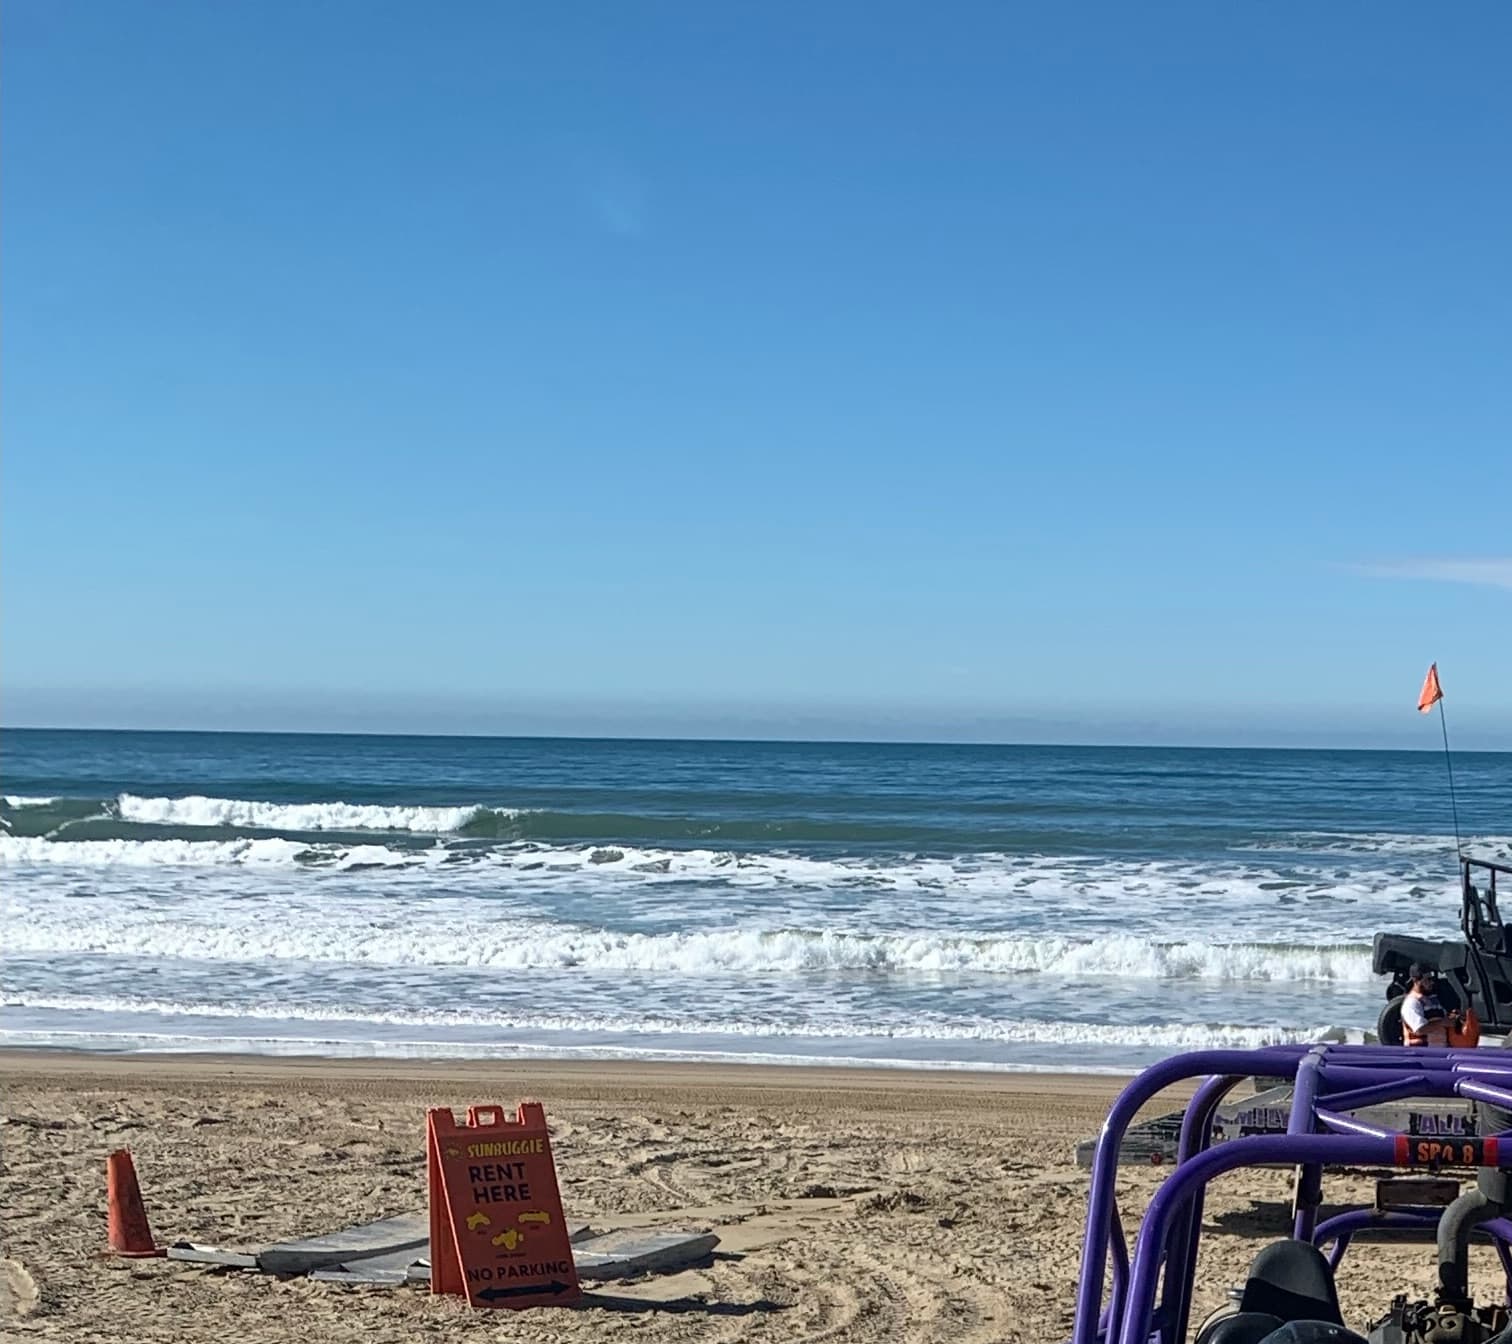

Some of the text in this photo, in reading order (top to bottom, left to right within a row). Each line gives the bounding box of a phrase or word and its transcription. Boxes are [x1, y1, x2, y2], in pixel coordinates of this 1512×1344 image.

[467, 1139, 544, 1158] SUNBUGGIE
[468, 1162, 526, 1183] RENT
[473, 1184, 532, 1204] HERE
[467, 1261, 570, 1282] NO PARKING
